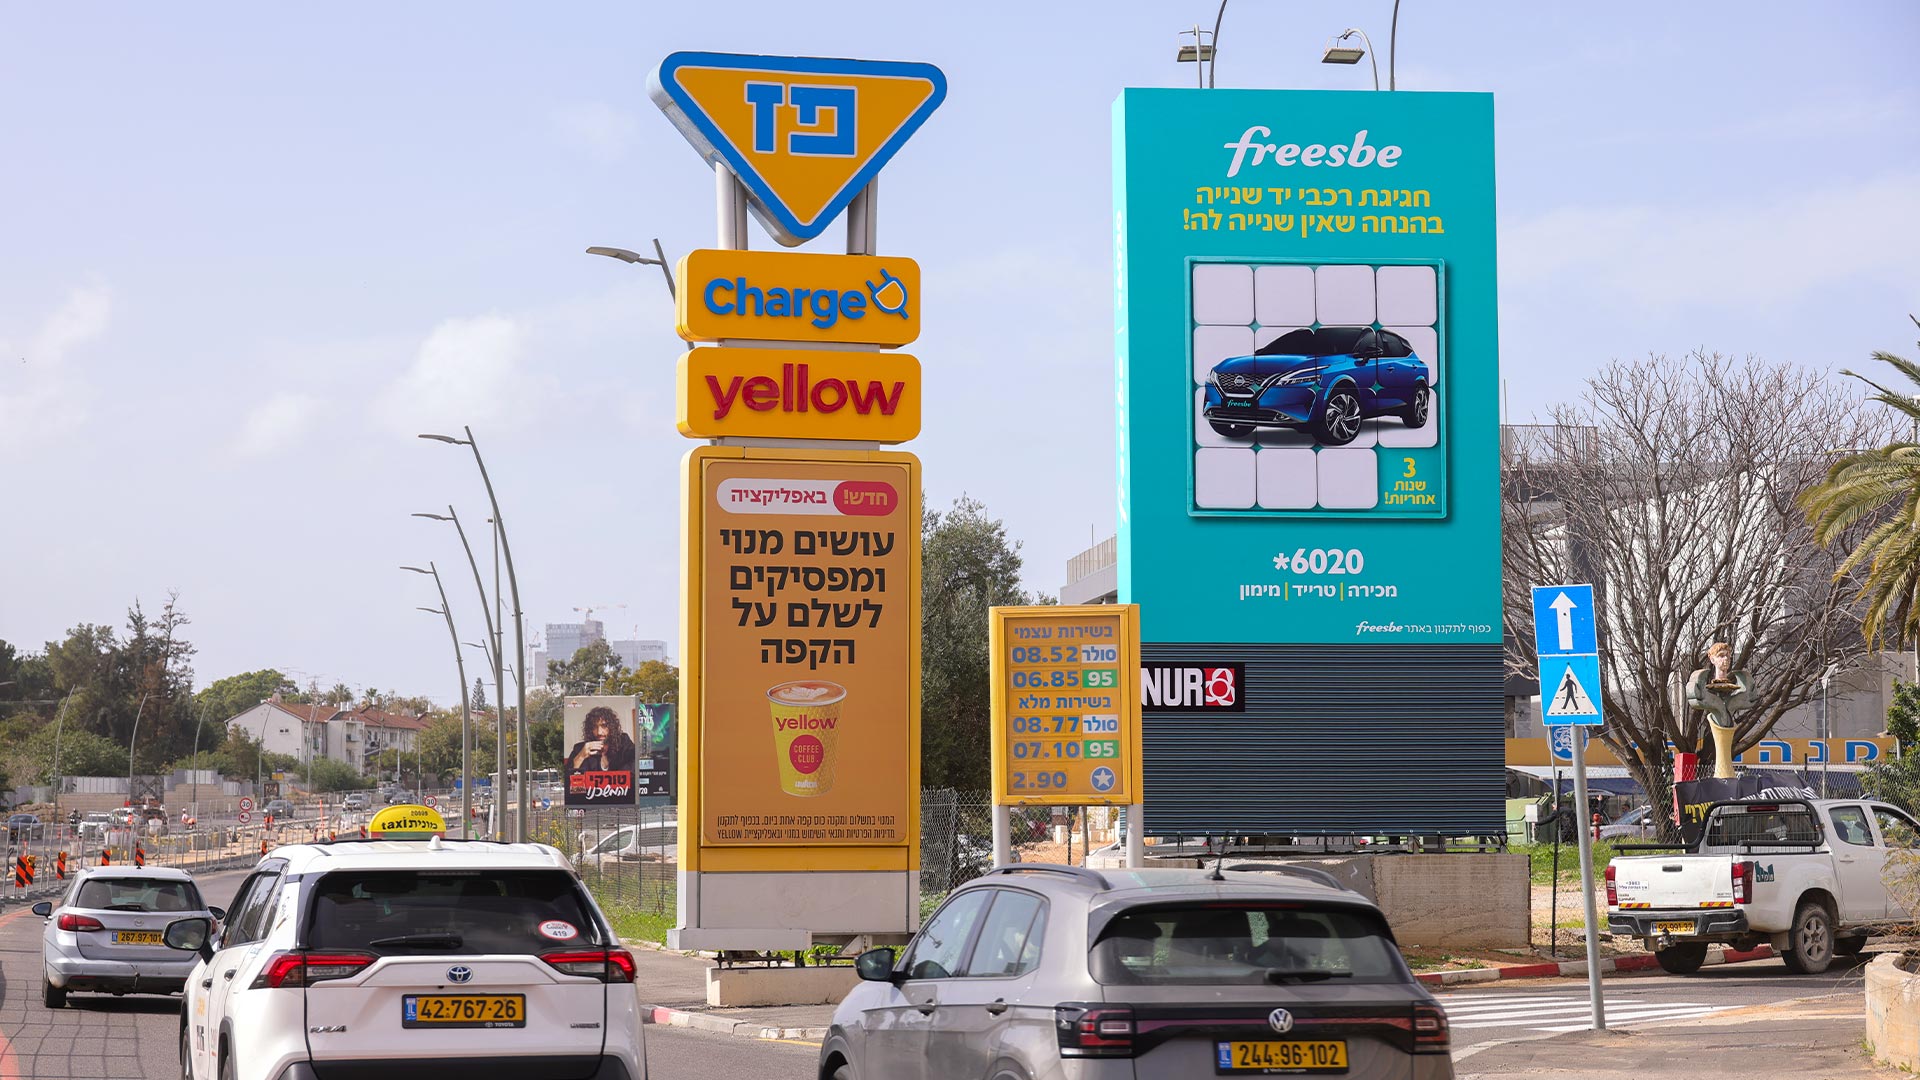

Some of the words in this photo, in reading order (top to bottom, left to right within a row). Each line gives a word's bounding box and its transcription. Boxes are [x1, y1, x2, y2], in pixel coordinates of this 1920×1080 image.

[745, 82, 857, 157] פז
[1223, 125, 1402, 178] freesbe
[1196, 186, 1262, 205] שנייה
[1268, 187, 1291, 205] יד
[1299, 188, 1353, 206] רכבי
[1358, 188, 1431, 207] חגיגת
[1183, 208, 1223, 230] לה!
[1229, 213, 1294, 232] שנייה
[1301, 214, 1355, 238] שאין
[1362, 215, 1444, 234] בהנחה
[704, 277, 867, 329] Charge
[705, 363, 905, 420] yellow
[1403, 457, 1416, 478] 3
[1394, 480, 1426, 491] שנות
[731, 488, 827, 506] באפליקציה
[844, 489, 888, 506] חדש!
[1384, 491, 1436, 505] אחריות!
[720, 529, 784, 555] מנוי
[794, 530, 895, 557] עושים
[730, 565, 886, 598] ומפסיקים
[1239, 584, 1281, 601] מימון
[1292, 584, 1336, 597] טרייד
[1348, 585, 1398, 597] מכירה
[732, 597, 777, 627] על
[788, 599, 883, 628] לשלם
[1014, 626, 1051, 639] עצמי
[1058, 625, 1113, 638] בשירות
[1356, 621, 1404, 635] freesbe
[1404, 624, 1432, 633] באתר
[1434, 622, 1466, 634] לתקנון
[1468, 624, 1491, 634] כפוף
[761, 638, 855, 670] הקפה
[1012, 647, 1078, 663] 08.52
[1082, 646, 1117, 662] סולר
[1013, 671, 1079, 688] 06.85
[1087, 671, 1113, 687] 95
[1141, 668, 1203, 706] NUR
[1018, 693, 1051, 709] מלא
[1055, 696, 1111, 708] בשירות
[776, 714, 837, 731] yellow
[1013, 716, 1080, 733] 08.77
[1083, 716, 1118, 732] סולר
[793, 745, 819, 753] COFFEE
[1013, 742, 1080, 758] 07.10
[1089, 742, 1114, 757] 95
[797, 755, 815, 763] CLUB
[589, 775, 626, 787] טורקי
[1013, 771, 1067, 788] 2.90
[382, 817, 407, 830] taxi
[408, 820, 438, 829] מונית
[779, 815, 796, 825] אחת
[717, 829, 742, 839] YELLOW
